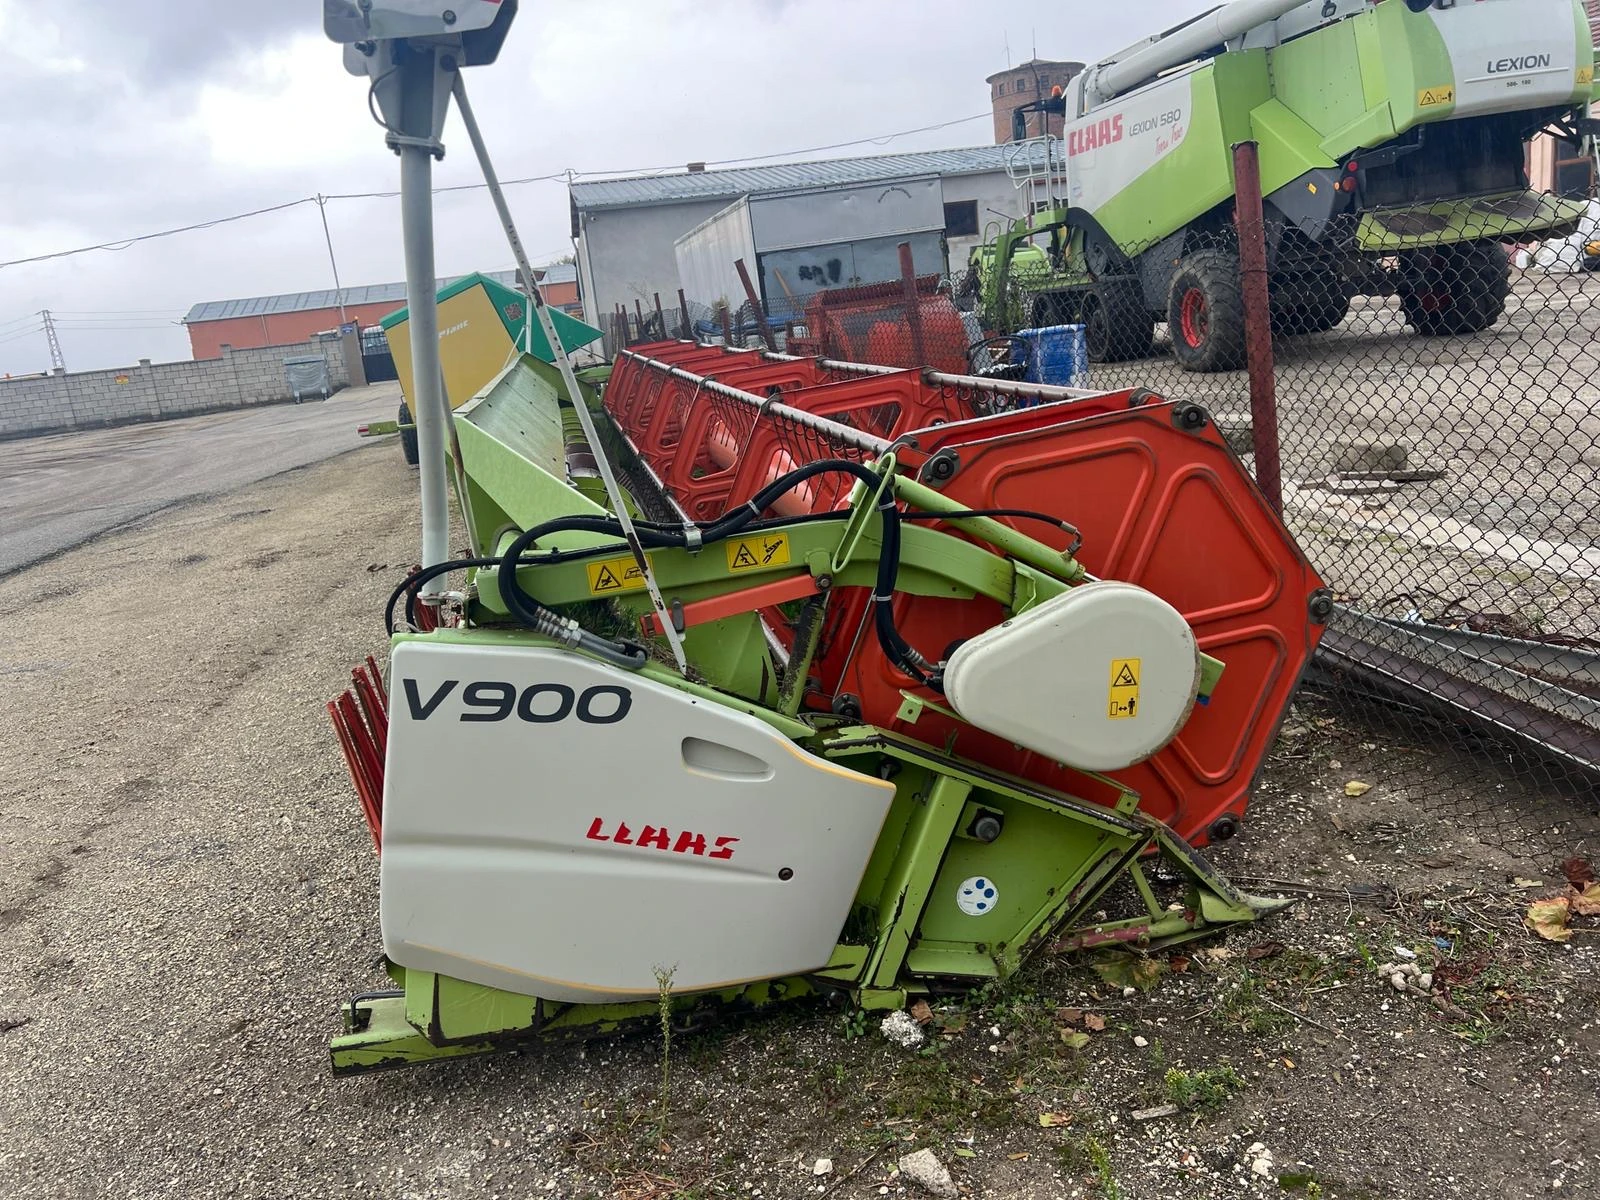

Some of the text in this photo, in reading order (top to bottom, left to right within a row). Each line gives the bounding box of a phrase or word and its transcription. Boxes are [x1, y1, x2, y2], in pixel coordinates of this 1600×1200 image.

[1486, 53, 1551, 74] LEXION
[1068, 113, 1123, 157] CLAAS
[1129, 109, 1182, 137] LEXION 580
[402, 678, 633, 725] V900
